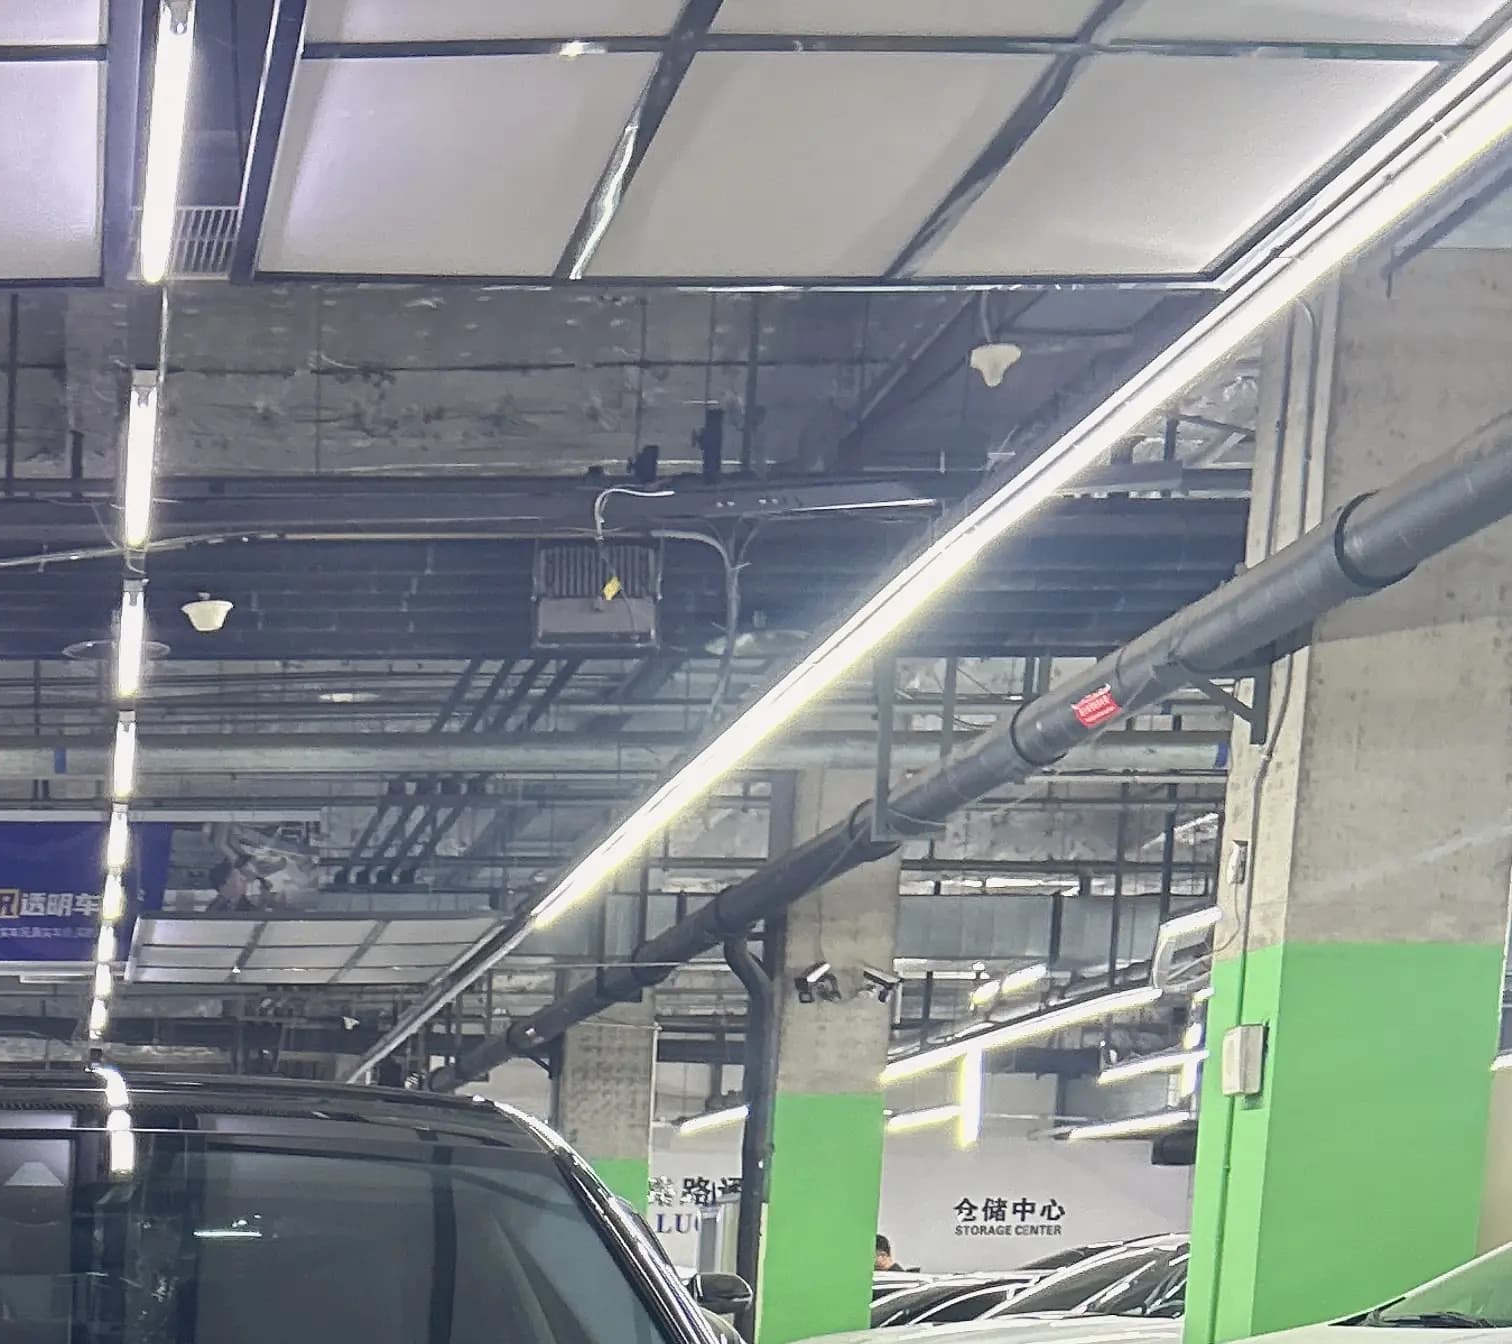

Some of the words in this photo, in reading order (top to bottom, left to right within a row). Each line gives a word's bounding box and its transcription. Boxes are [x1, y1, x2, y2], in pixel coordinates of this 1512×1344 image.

[953, 1197, 1066, 1223] 仓储中心
[656, 1213, 699, 1234] LU
[954, 1225, 1012, 1236] STORAGE
[1014, 1225, 1062, 1236] CENTER
